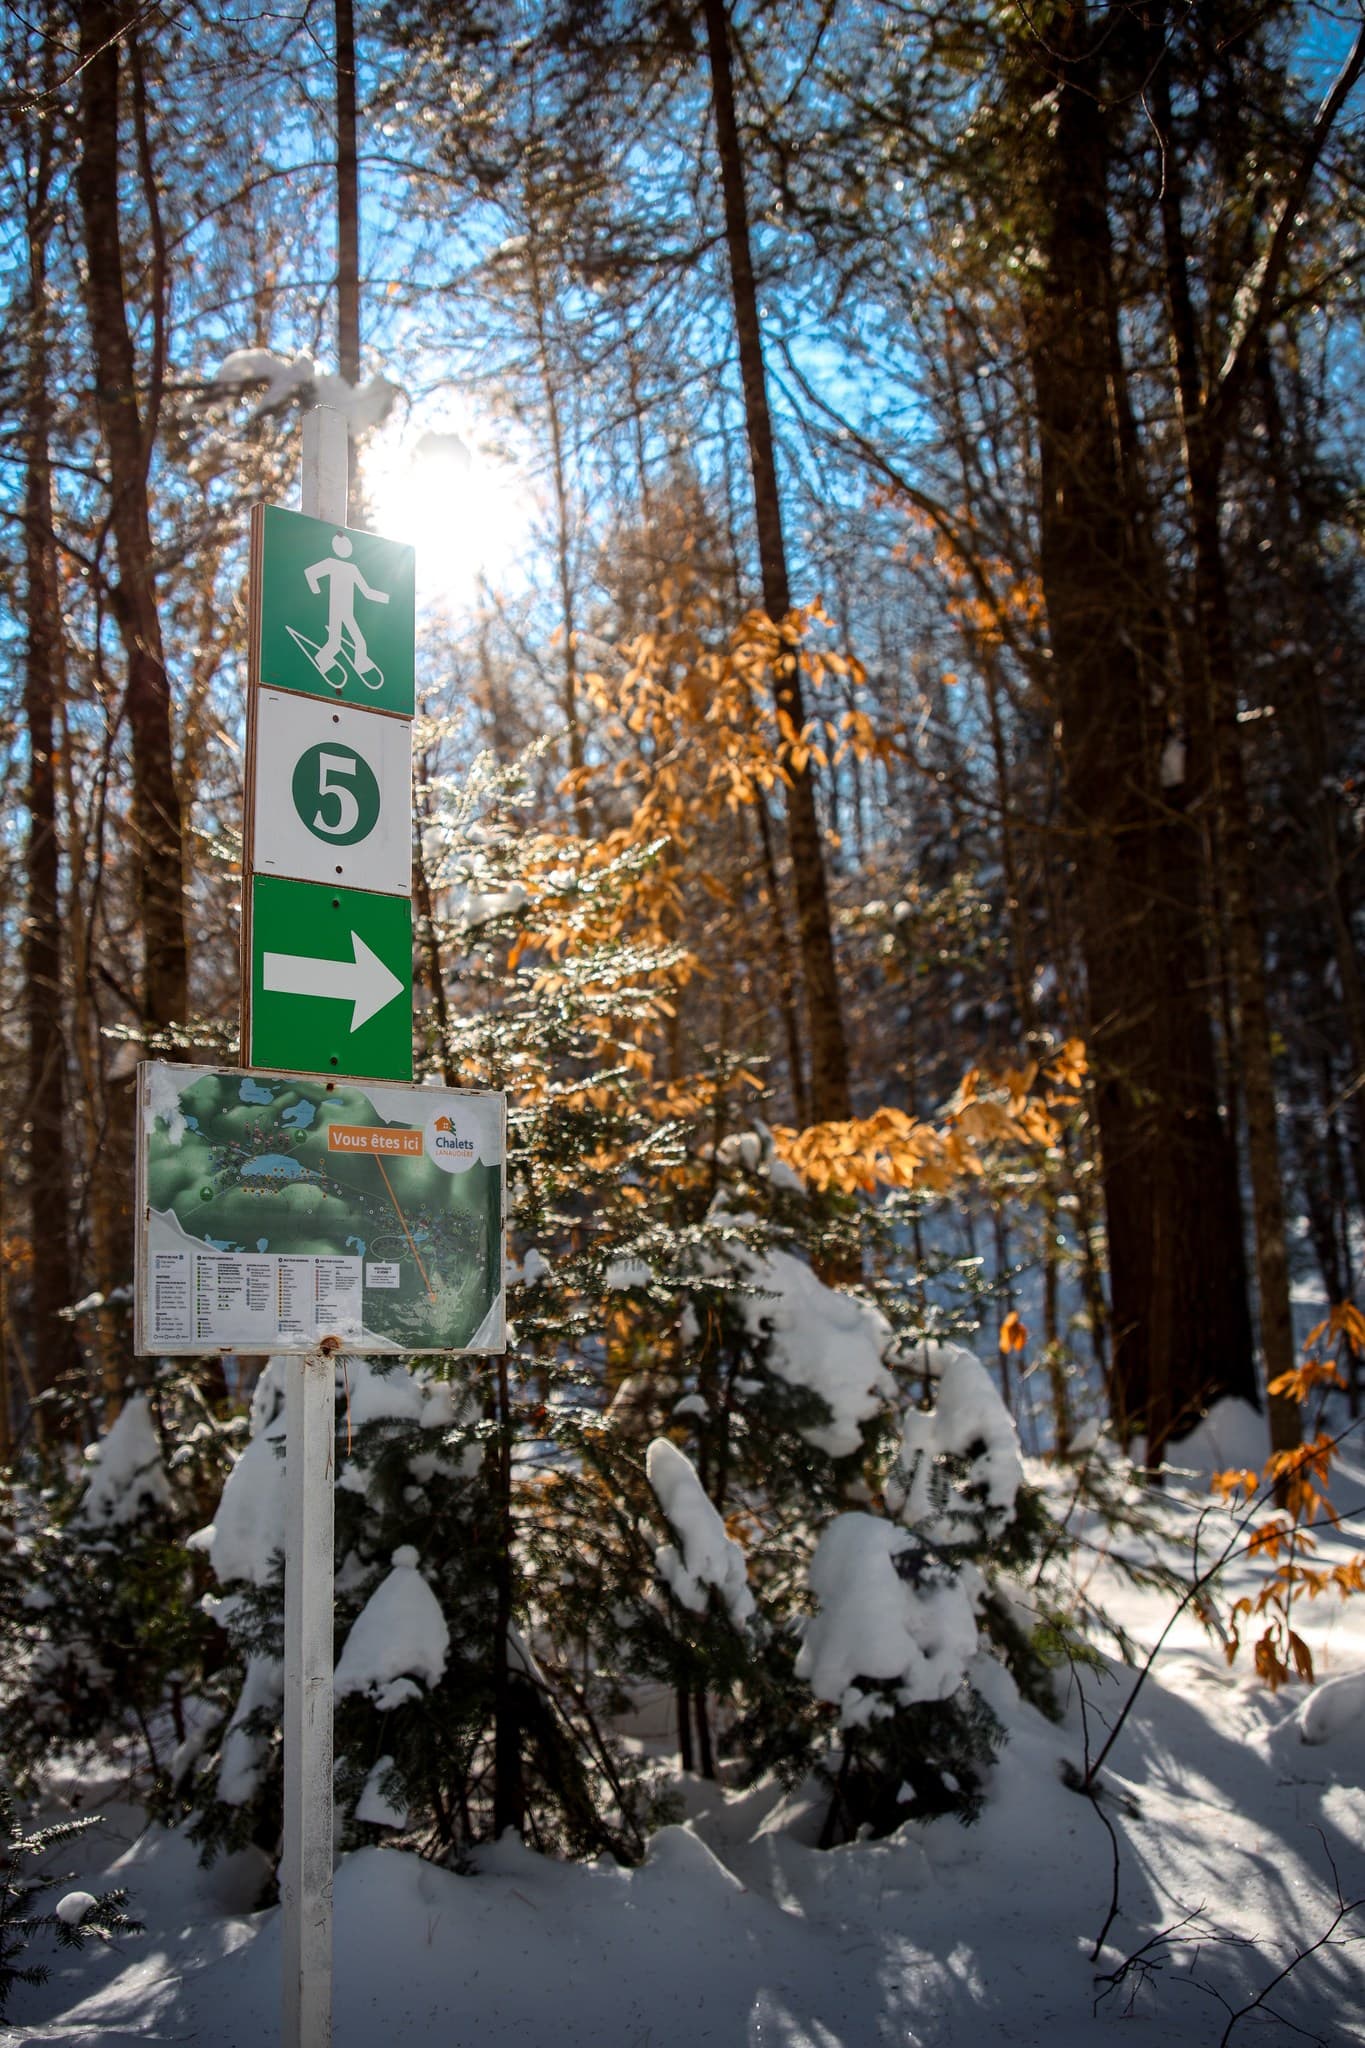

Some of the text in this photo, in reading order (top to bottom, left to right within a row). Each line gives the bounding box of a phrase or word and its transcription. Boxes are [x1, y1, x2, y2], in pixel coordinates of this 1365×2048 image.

[313, 752, 359, 835] 5
[333, 1131, 419, 1150] Vous êtes ici
[436, 1136, 474, 1150] Chalets
